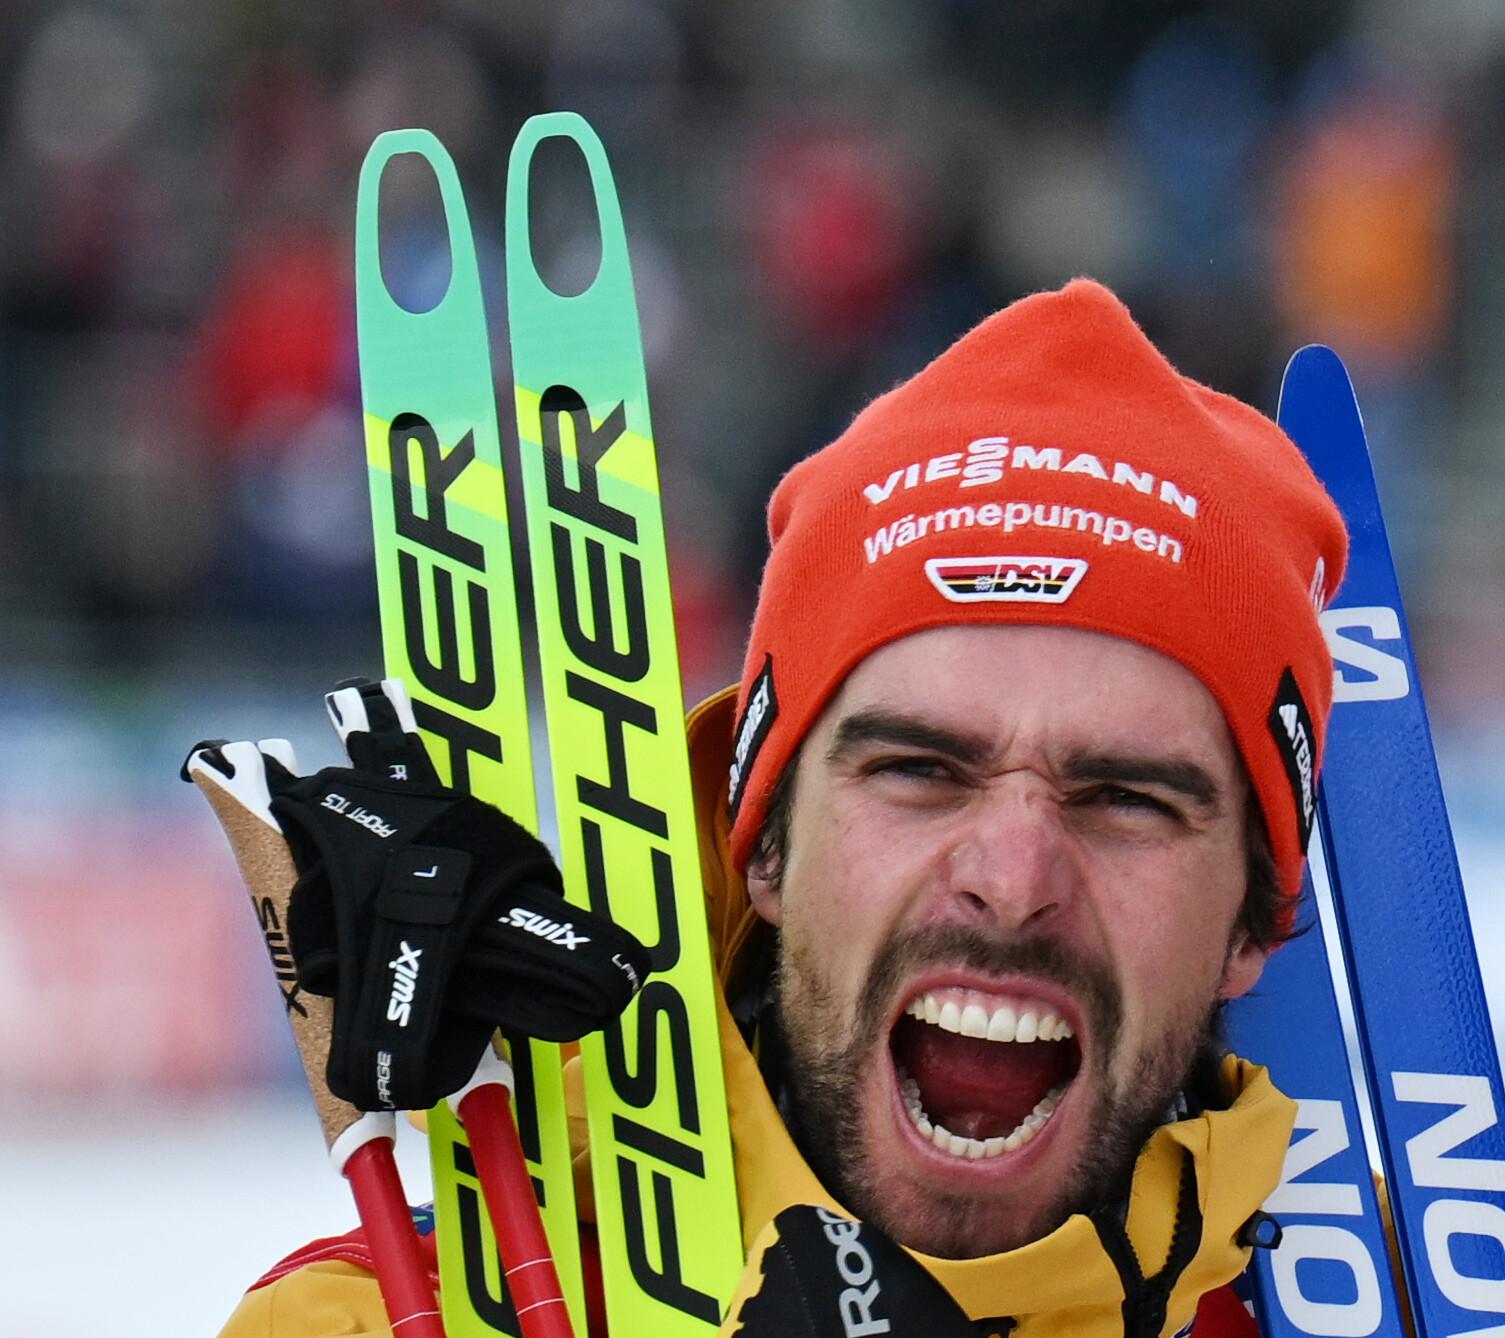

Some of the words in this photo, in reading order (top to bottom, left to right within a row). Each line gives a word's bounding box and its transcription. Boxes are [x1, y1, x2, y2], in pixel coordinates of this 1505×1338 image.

[862, 435, 1199, 520] VIESSMANN
[863, 501, 1184, 565] Wärmepumpen
[999, 564, 1074, 595] DSV
[320, 793, 351, 816] TCS
[540, 384, 723, 1327] FISCHER
[387, 940, 423, 1028] swix
